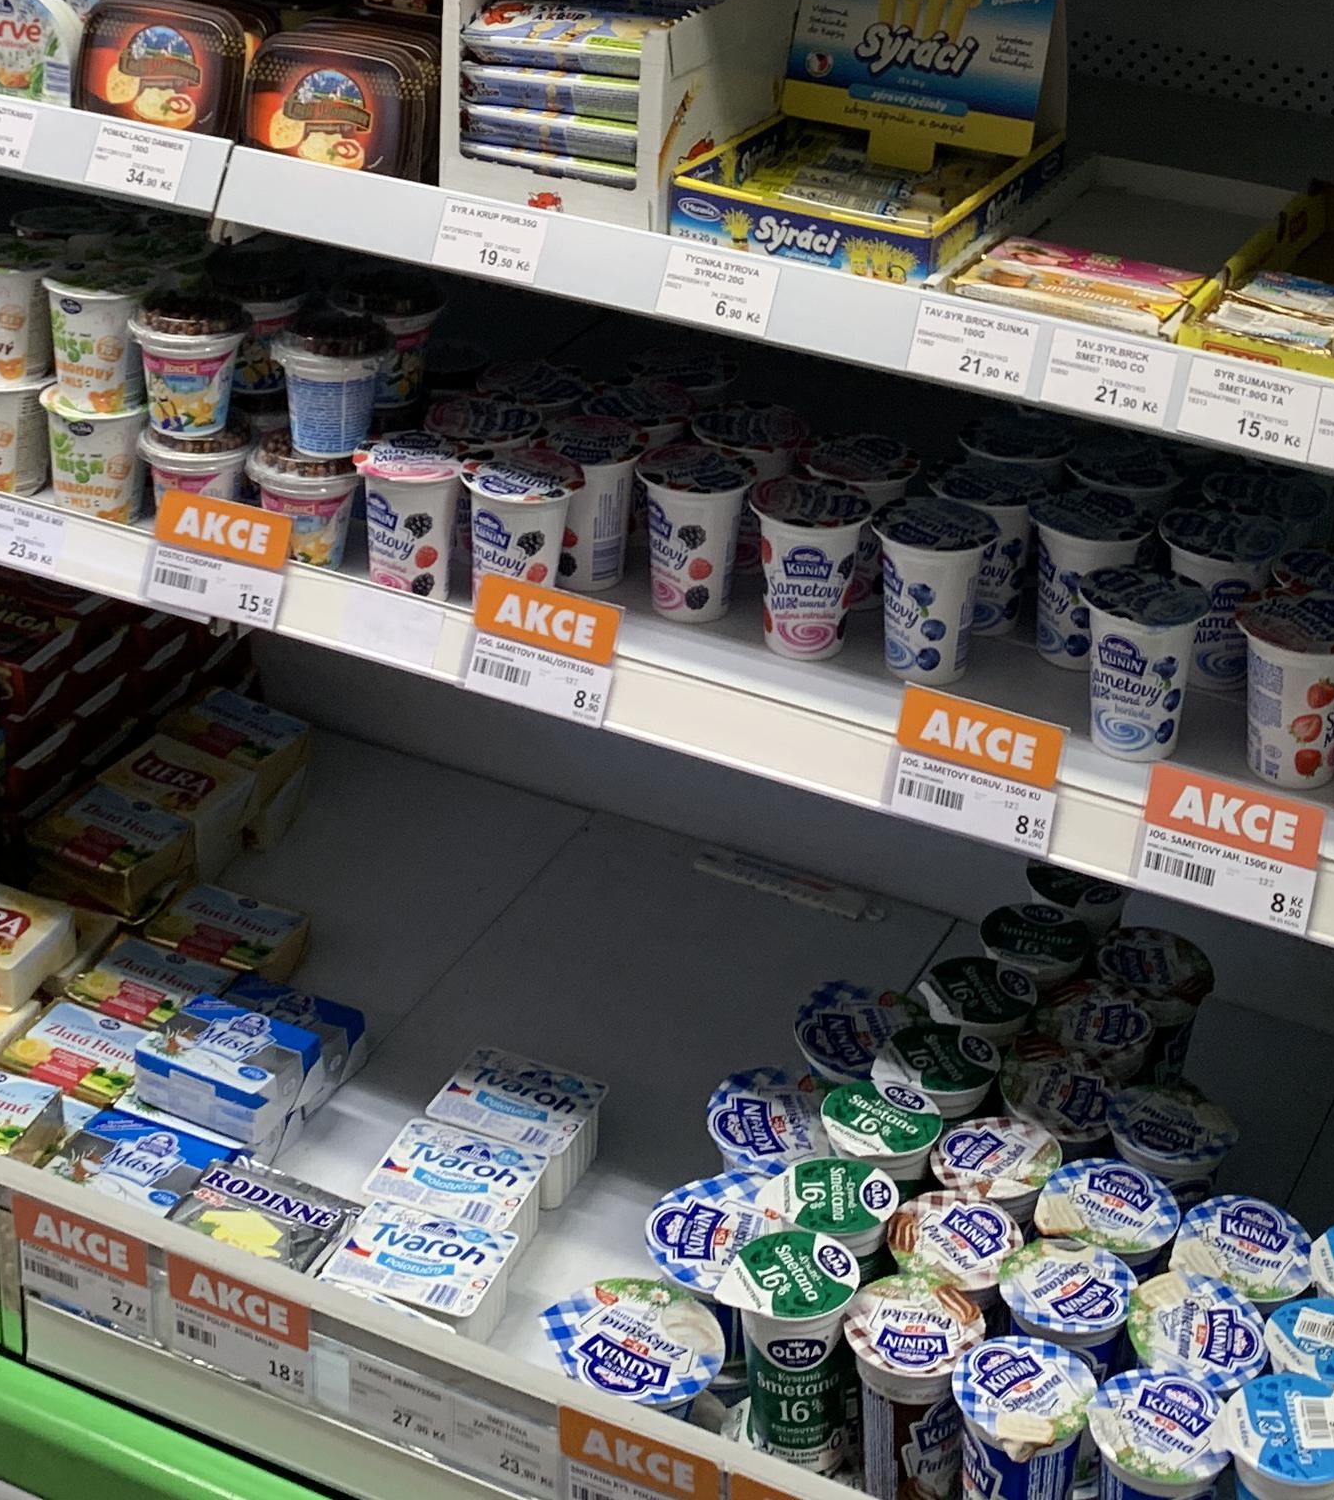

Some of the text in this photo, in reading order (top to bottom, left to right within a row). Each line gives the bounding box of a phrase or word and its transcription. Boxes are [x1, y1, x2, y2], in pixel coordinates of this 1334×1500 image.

[854, 22, 978, 76] Sýráci
[755, 215, 841, 256] Sýráci
[478, 249, 531, 272] 19,50 Kč
[684, 253, 761, 277] TYCINKA SYROVA
[693, 268, 745, 286] SYRACI 20G
[715, 300, 761, 325] 6,90 Kč
[924, 307, 1030, 337] TAV.SYR.BRICK SUNKA
[962, 327, 985, 340] 100G
[958, 355, 1020, 383] 21,90 Kč
[1214, 368, 1294, 396] SYR SUMAVSKY
[1094, 385, 1158, 414] 21,90 Kč
[1236, 418, 1301, 448] 15,90 Kč
[175, 506, 271, 554] AKCE
[237, 592, 260, 612] 15
[494, 593, 596, 648] AKCE
[920, 708, 1039, 770] AKCE
[902, 755, 920, 771] JOG.
[923, 759, 969, 783] SAMETOVY
[1005, 784, 1027, 797] 150G
[1028, 790, 1043, 801] KU
[1170, 784, 1299, 851] AKCE
[199, 1022, 263, 1061] Máslo
[848, 1095, 918, 1135] Smetana
[108, 1148, 172, 1182] Máslo
[408, 1141, 522, 1189] Tvaroh
[206, 1165, 339, 1231] RODINNÉ
[33, 1212, 129, 1269] AKCE
[372, 1219, 487, 1270] Tvaroh
[774, 1244, 819, 1303] Smetana
[188, 1271, 291, 1336] AKCE
[772, 1341, 823, 1358] OLMA
[582, 1428, 696, 1493] AKCE
